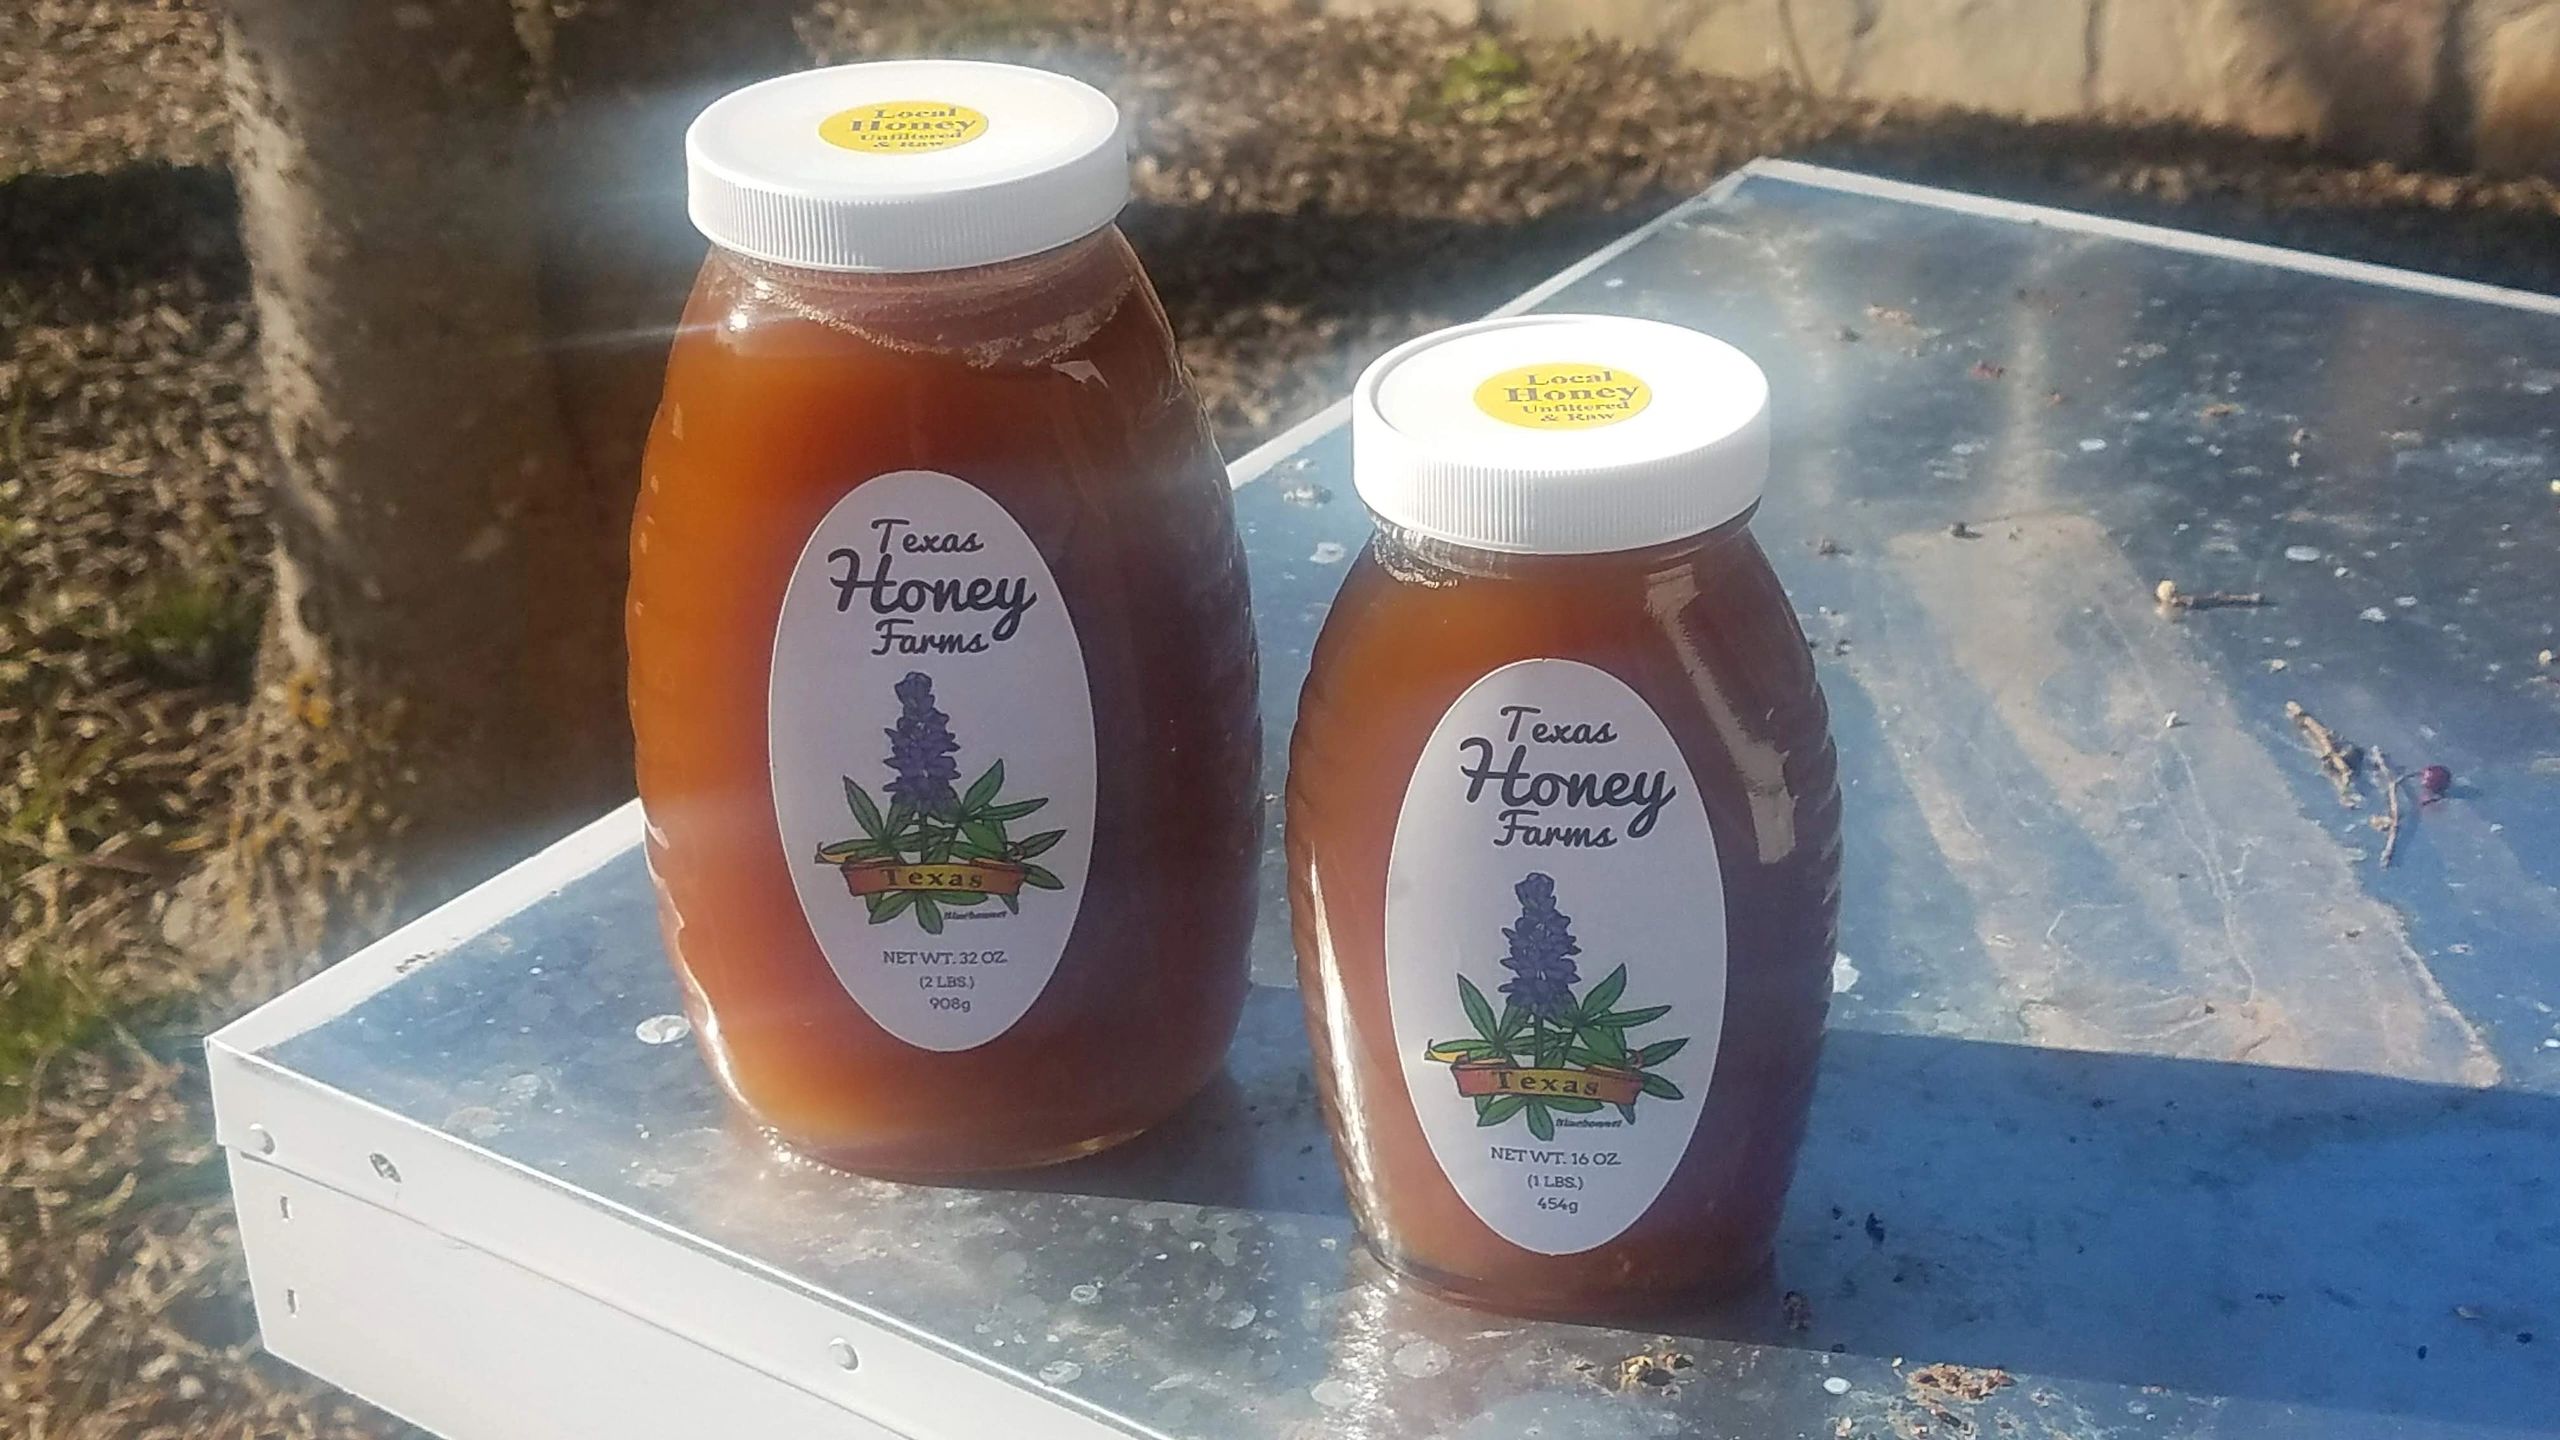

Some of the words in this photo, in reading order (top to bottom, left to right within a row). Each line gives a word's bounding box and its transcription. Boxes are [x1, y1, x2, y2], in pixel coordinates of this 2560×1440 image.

[874, 108, 957, 119] Local
[851, 120, 976, 132] Honey
[1527, 371, 1613, 386] Local
[1503, 386, 1639, 402] Honey
[1522, 401, 1630, 414] Unfiltered
[1541, 414, 1559, 422] &
[1567, 413, 1615, 422] Raw
[871, 518, 984, 554] Texas
[828, 548, 1037, 641] Honey
[871, 618, 989, 656] Farms
[1500, 706, 1617, 743] Texas
[1460, 737, 1676, 837] Honey
[1493, 809, 1617, 847] Farms
[880, 869, 983, 888] Texas
[883, 951, 918, 965] NET
[922, 952, 956, 965] WT.
[960, 952, 977, 965] 32
[919, 976, 933, 989] (2
[937, 976, 975, 989] LBS.)
[929, 997, 971, 1012] 908g
[1491, 1071, 1600, 1095] Texas
[1491, 1147, 1528, 1162] NET
[1530, 1151, 1567, 1165] WT.
[1571, 1153, 1589, 1165] 16
[1527, 1175, 1540, 1189] (1
[1543, 1175, 1584, 1190] LBS.)
[1537, 1197, 1579, 1214] 454g
